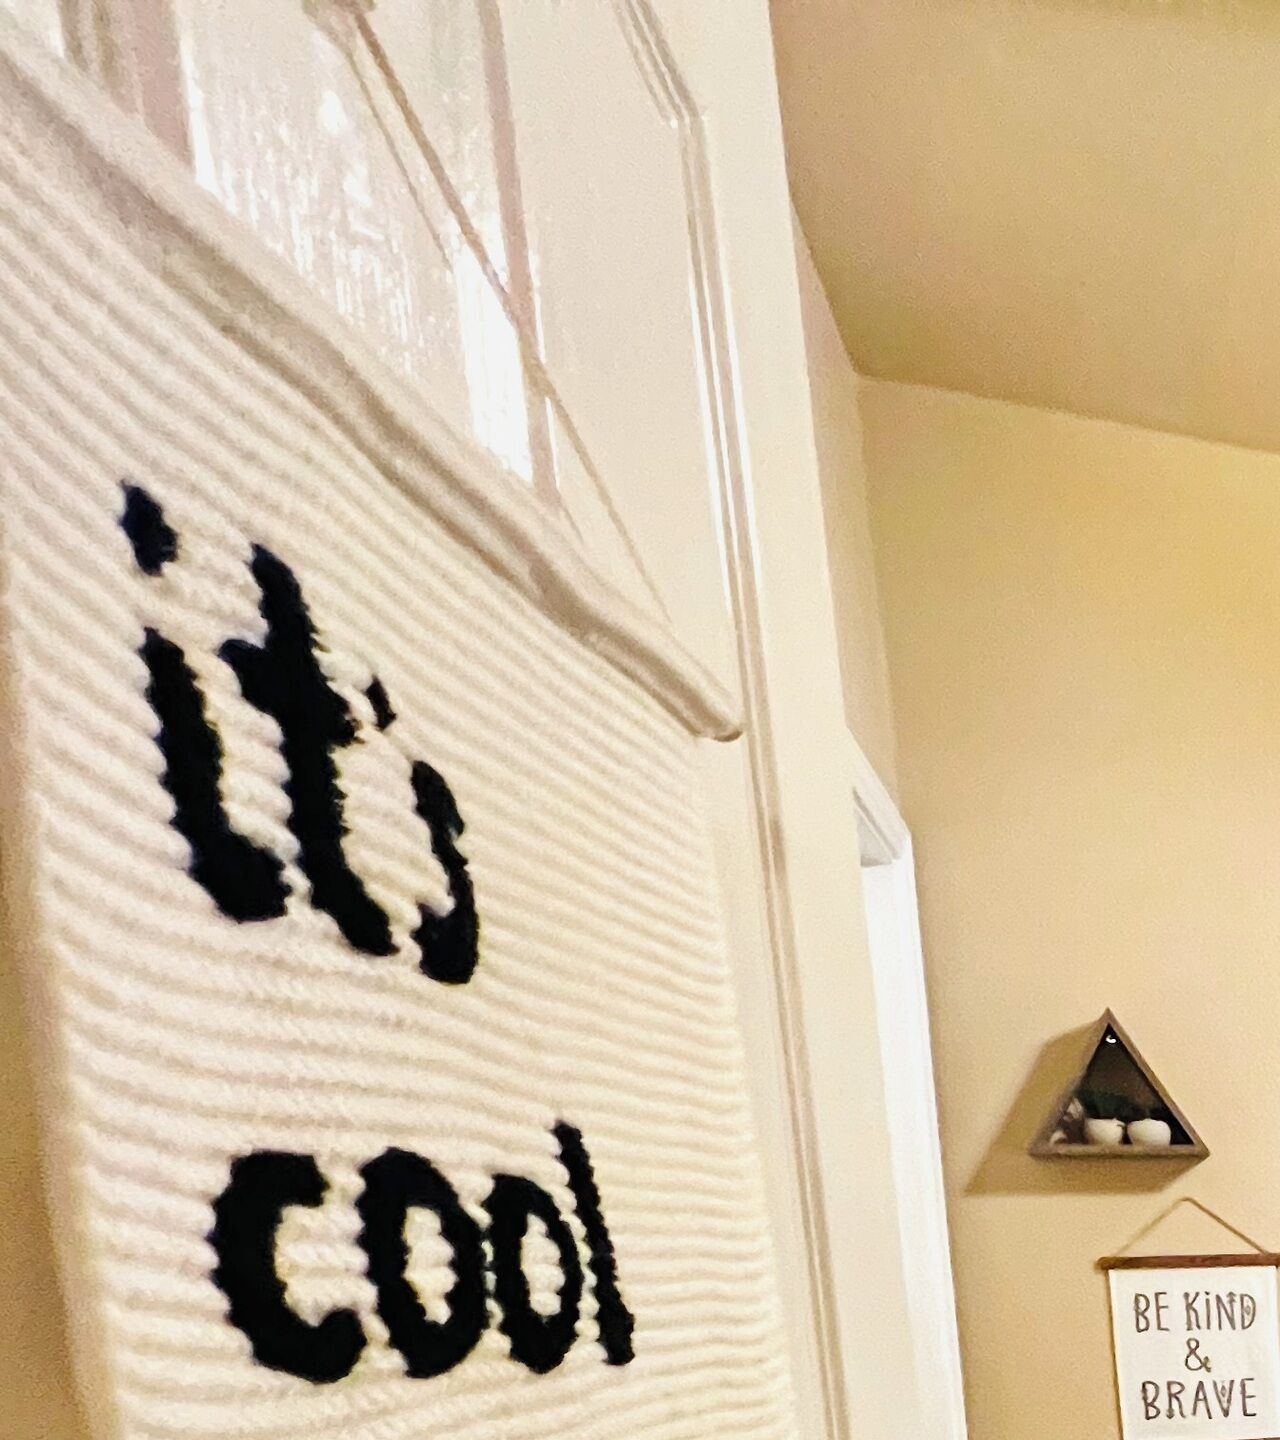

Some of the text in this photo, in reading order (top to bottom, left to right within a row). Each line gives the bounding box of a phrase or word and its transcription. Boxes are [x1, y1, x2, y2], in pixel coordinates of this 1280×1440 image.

[120, 481, 479, 985] it's
[209, 1119, 635, 1383] cool
[1134, 1291, 1170, 1333] BE
[1184, 1337, 1212, 1373] &
[1141, 1377, 1258, 1421] BRAVE
